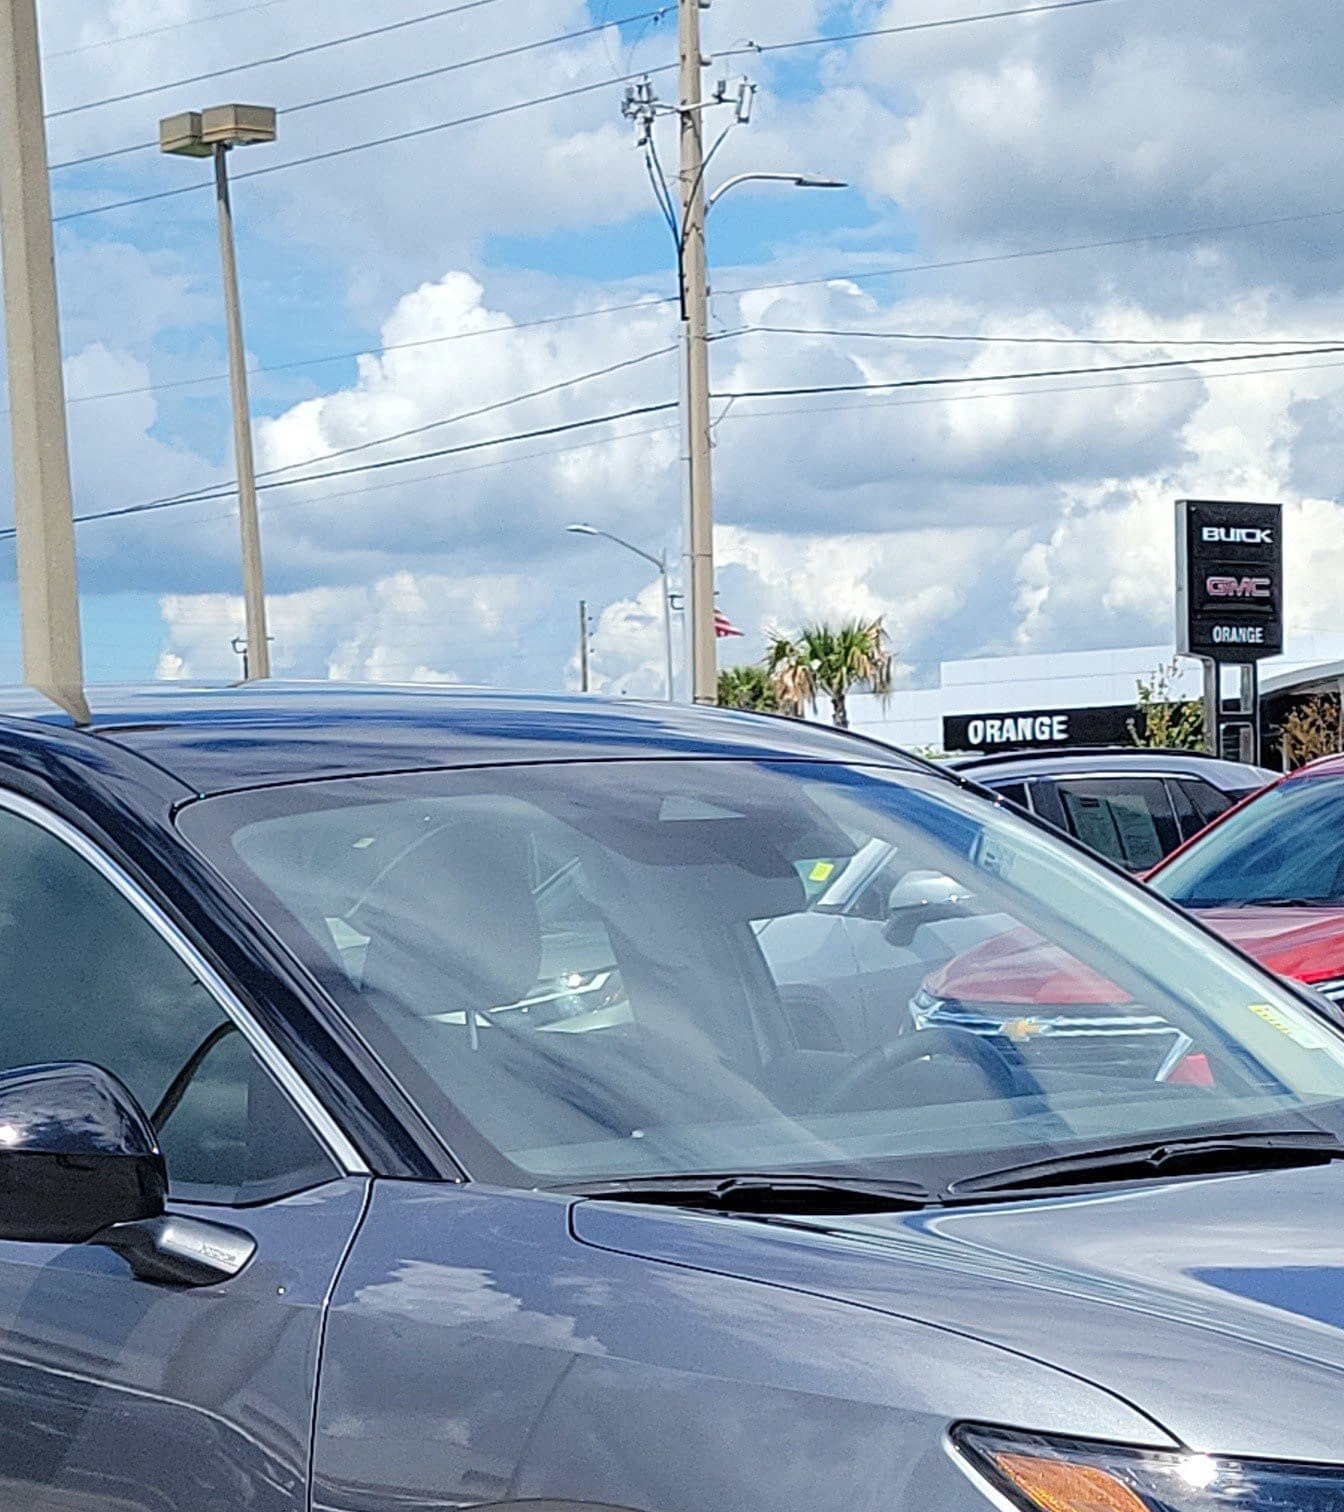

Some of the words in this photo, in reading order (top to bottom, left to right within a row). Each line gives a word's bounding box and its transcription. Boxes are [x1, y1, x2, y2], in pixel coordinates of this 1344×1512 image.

[1202, 527, 1273, 543] BUICK
[1206, 576, 1271, 597] GMC
[1212, 626, 1264, 643] ORANGE
[967, 715, 1069, 745] ORANGE
